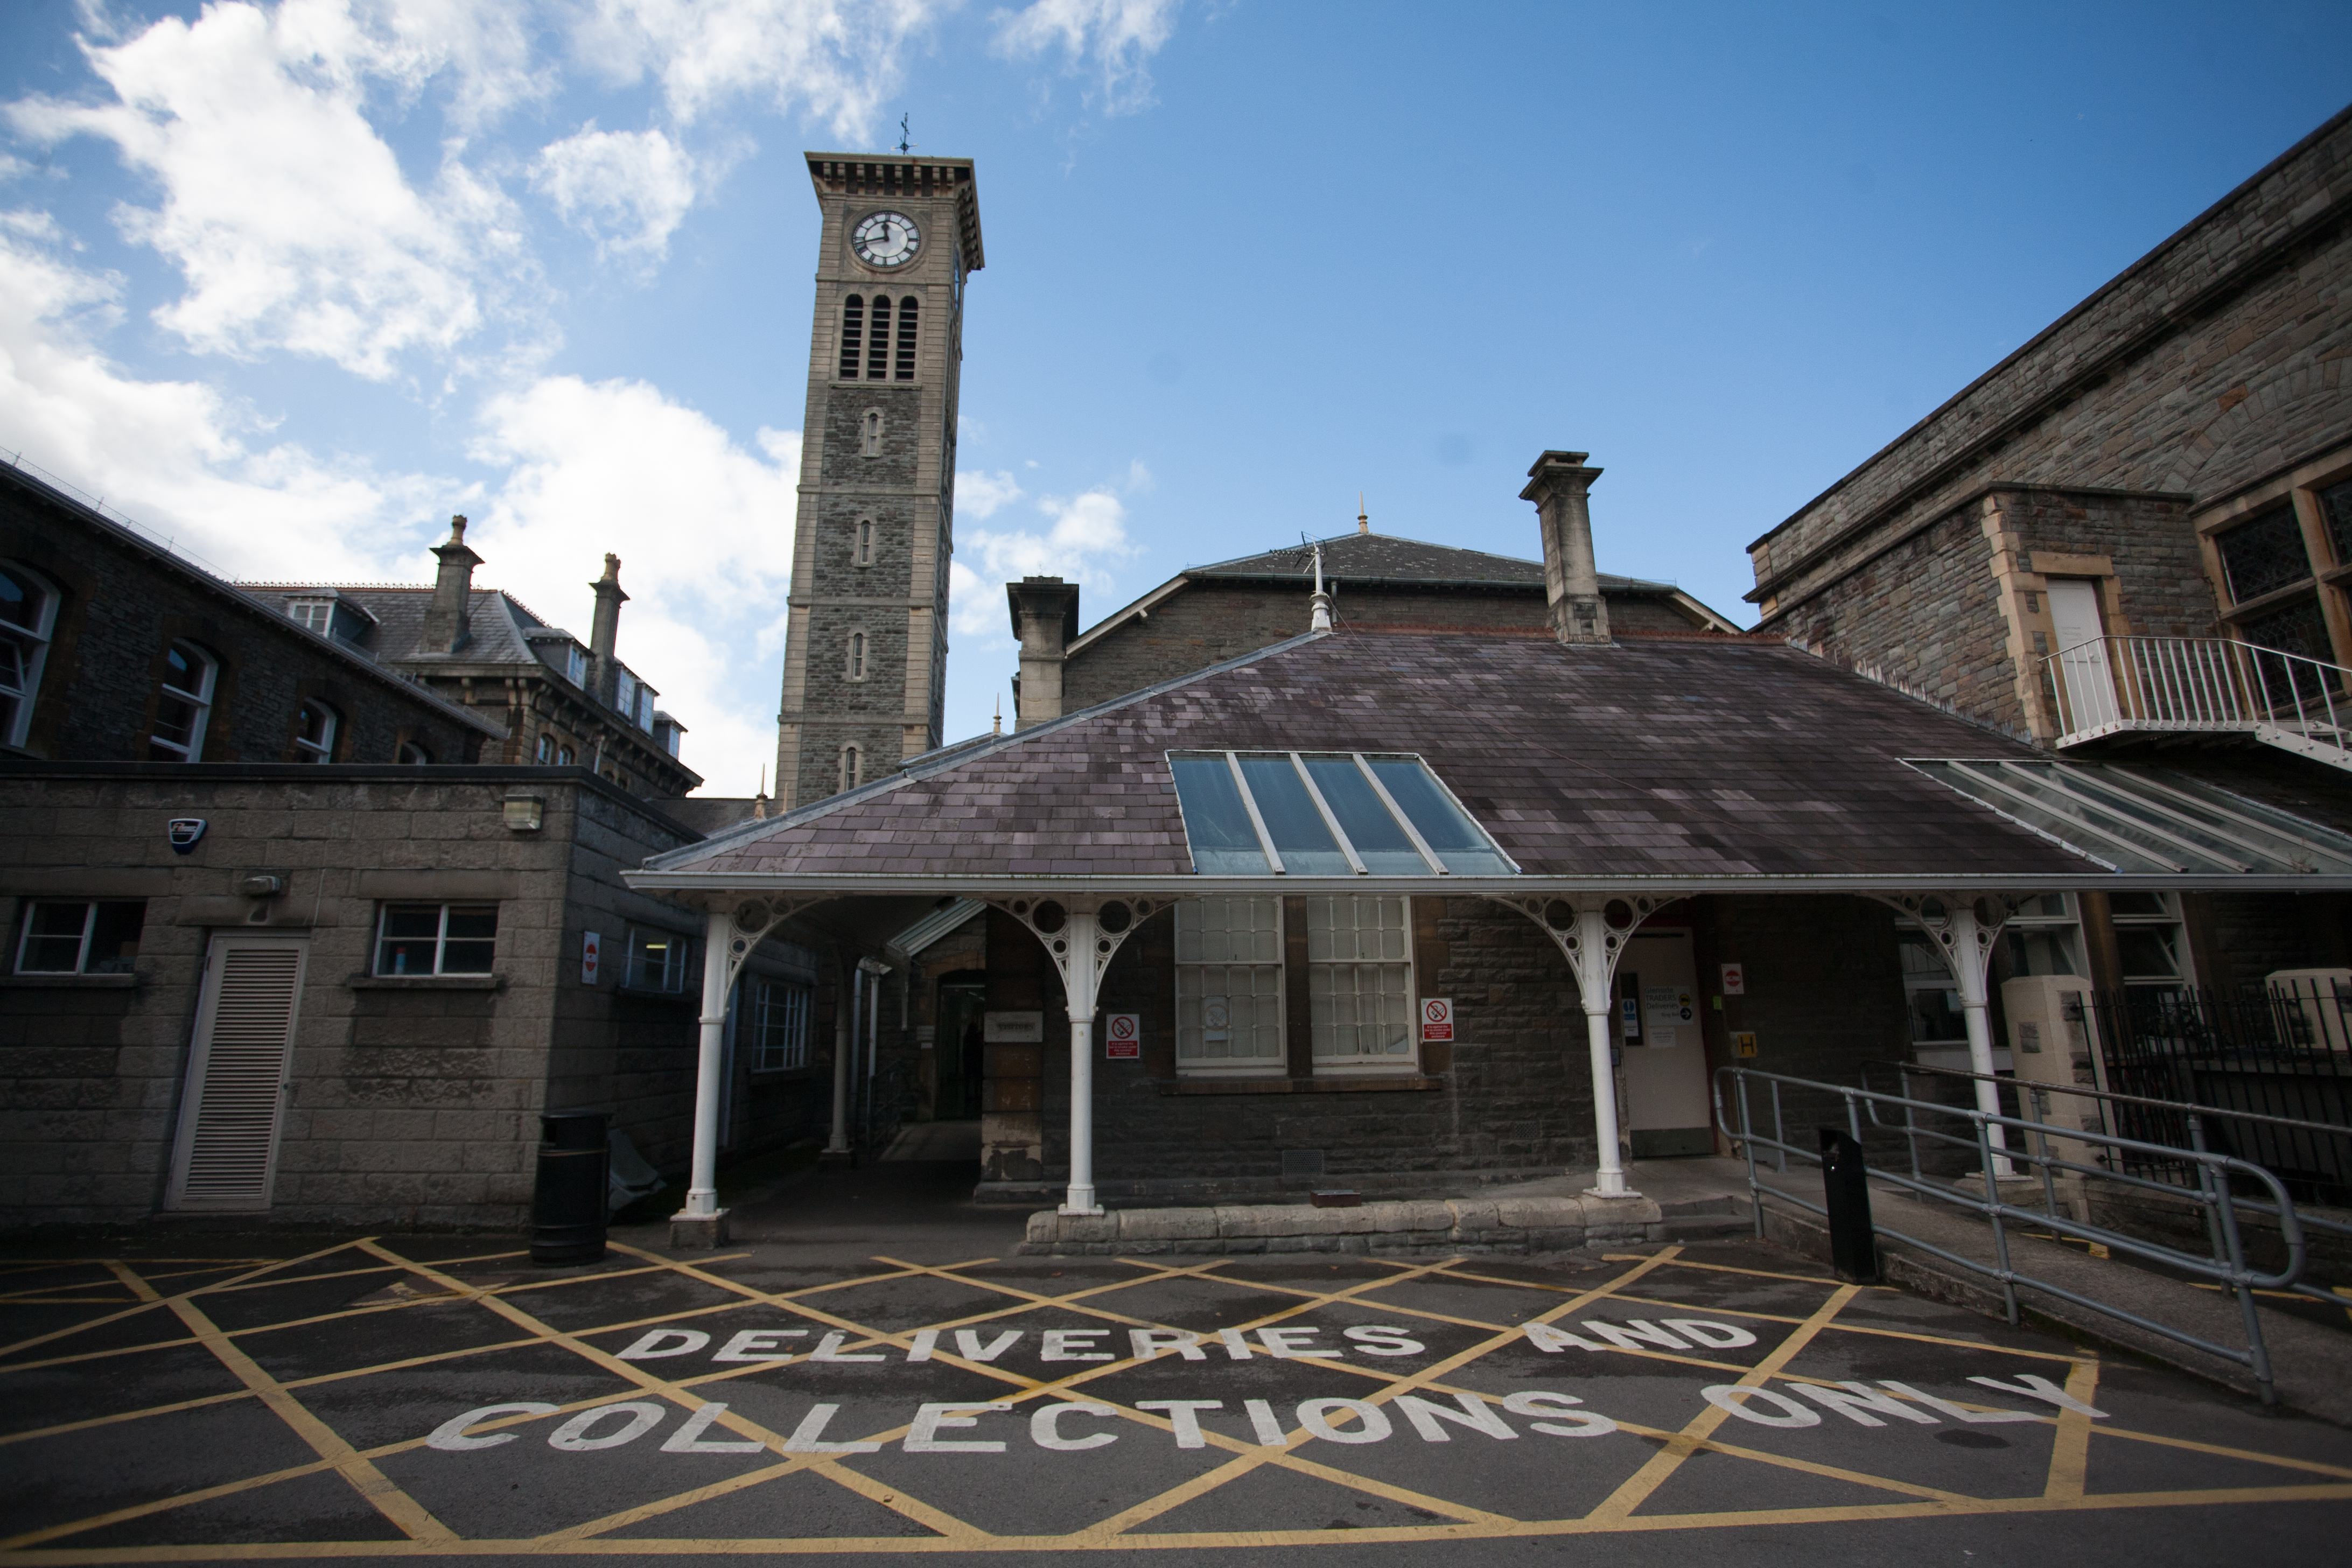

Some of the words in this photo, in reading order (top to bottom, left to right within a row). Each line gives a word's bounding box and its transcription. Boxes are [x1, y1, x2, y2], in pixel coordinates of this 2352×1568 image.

[996, 1022, 1034, 1030] VISITORS
[1740, 1037, 1754, 1053] H
[614, 1326, 1426, 1362] DELIVERIES
[1522, 1319, 1757, 1352] AND
[424, 1390, 1617, 1454] COLLECTIONS
[1700, 1374, 2110, 1428] ONLY
